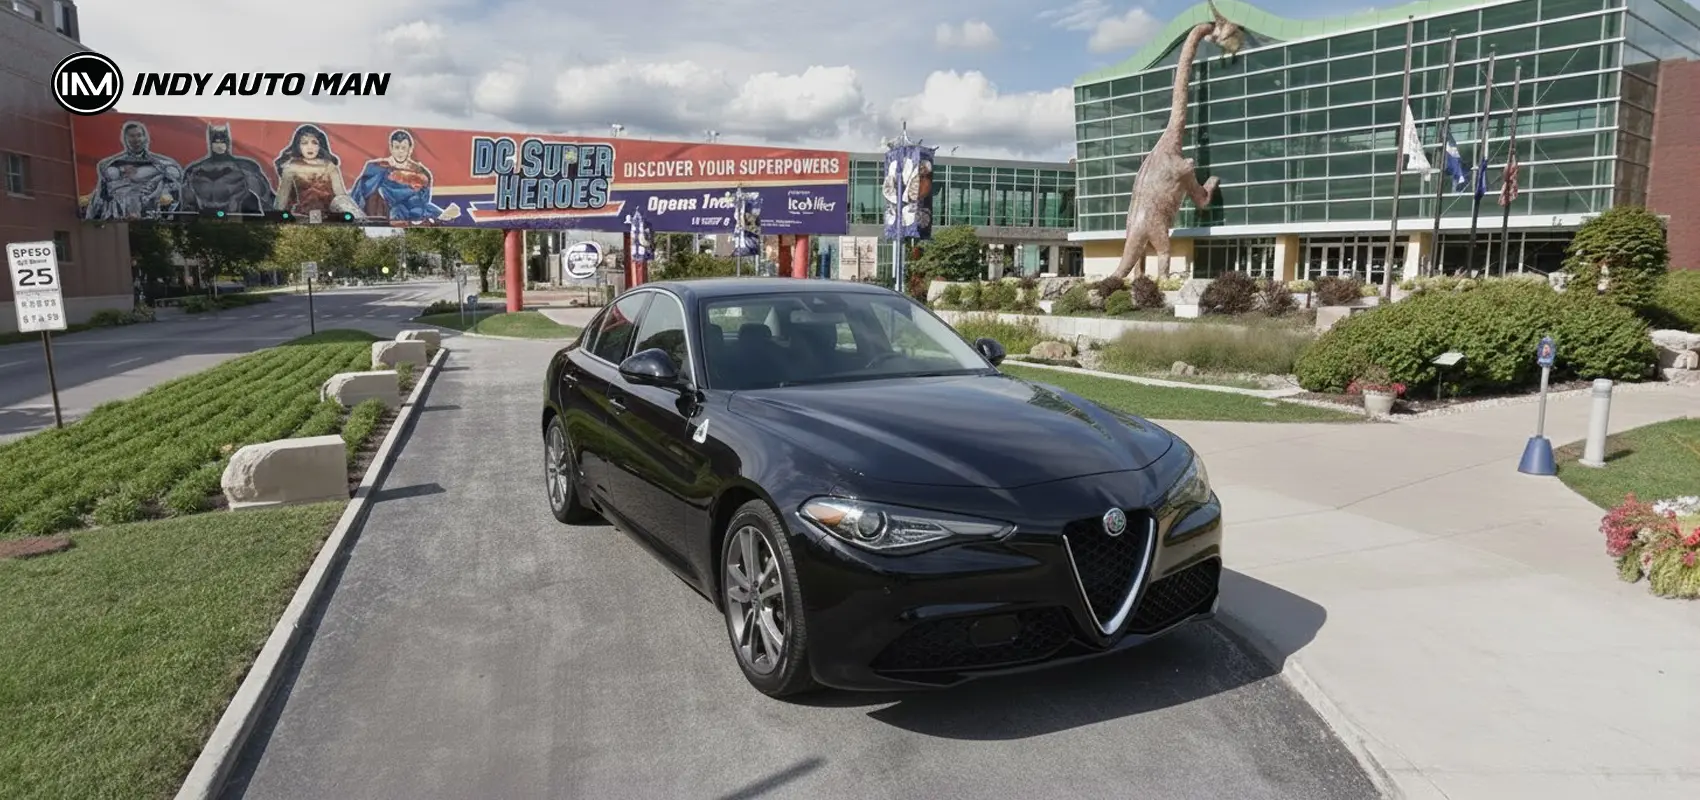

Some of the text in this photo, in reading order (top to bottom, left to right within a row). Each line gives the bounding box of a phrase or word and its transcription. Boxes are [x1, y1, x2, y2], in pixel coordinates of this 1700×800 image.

[473, 138, 614, 178] DC SUPER
[624, 158, 840, 178] DISCOVER YOUR SUPERPOWERS
[497, 174, 609, 211] HEROES
[647, 195, 697, 216] Opens
[17, 268, 53, 287] 25
